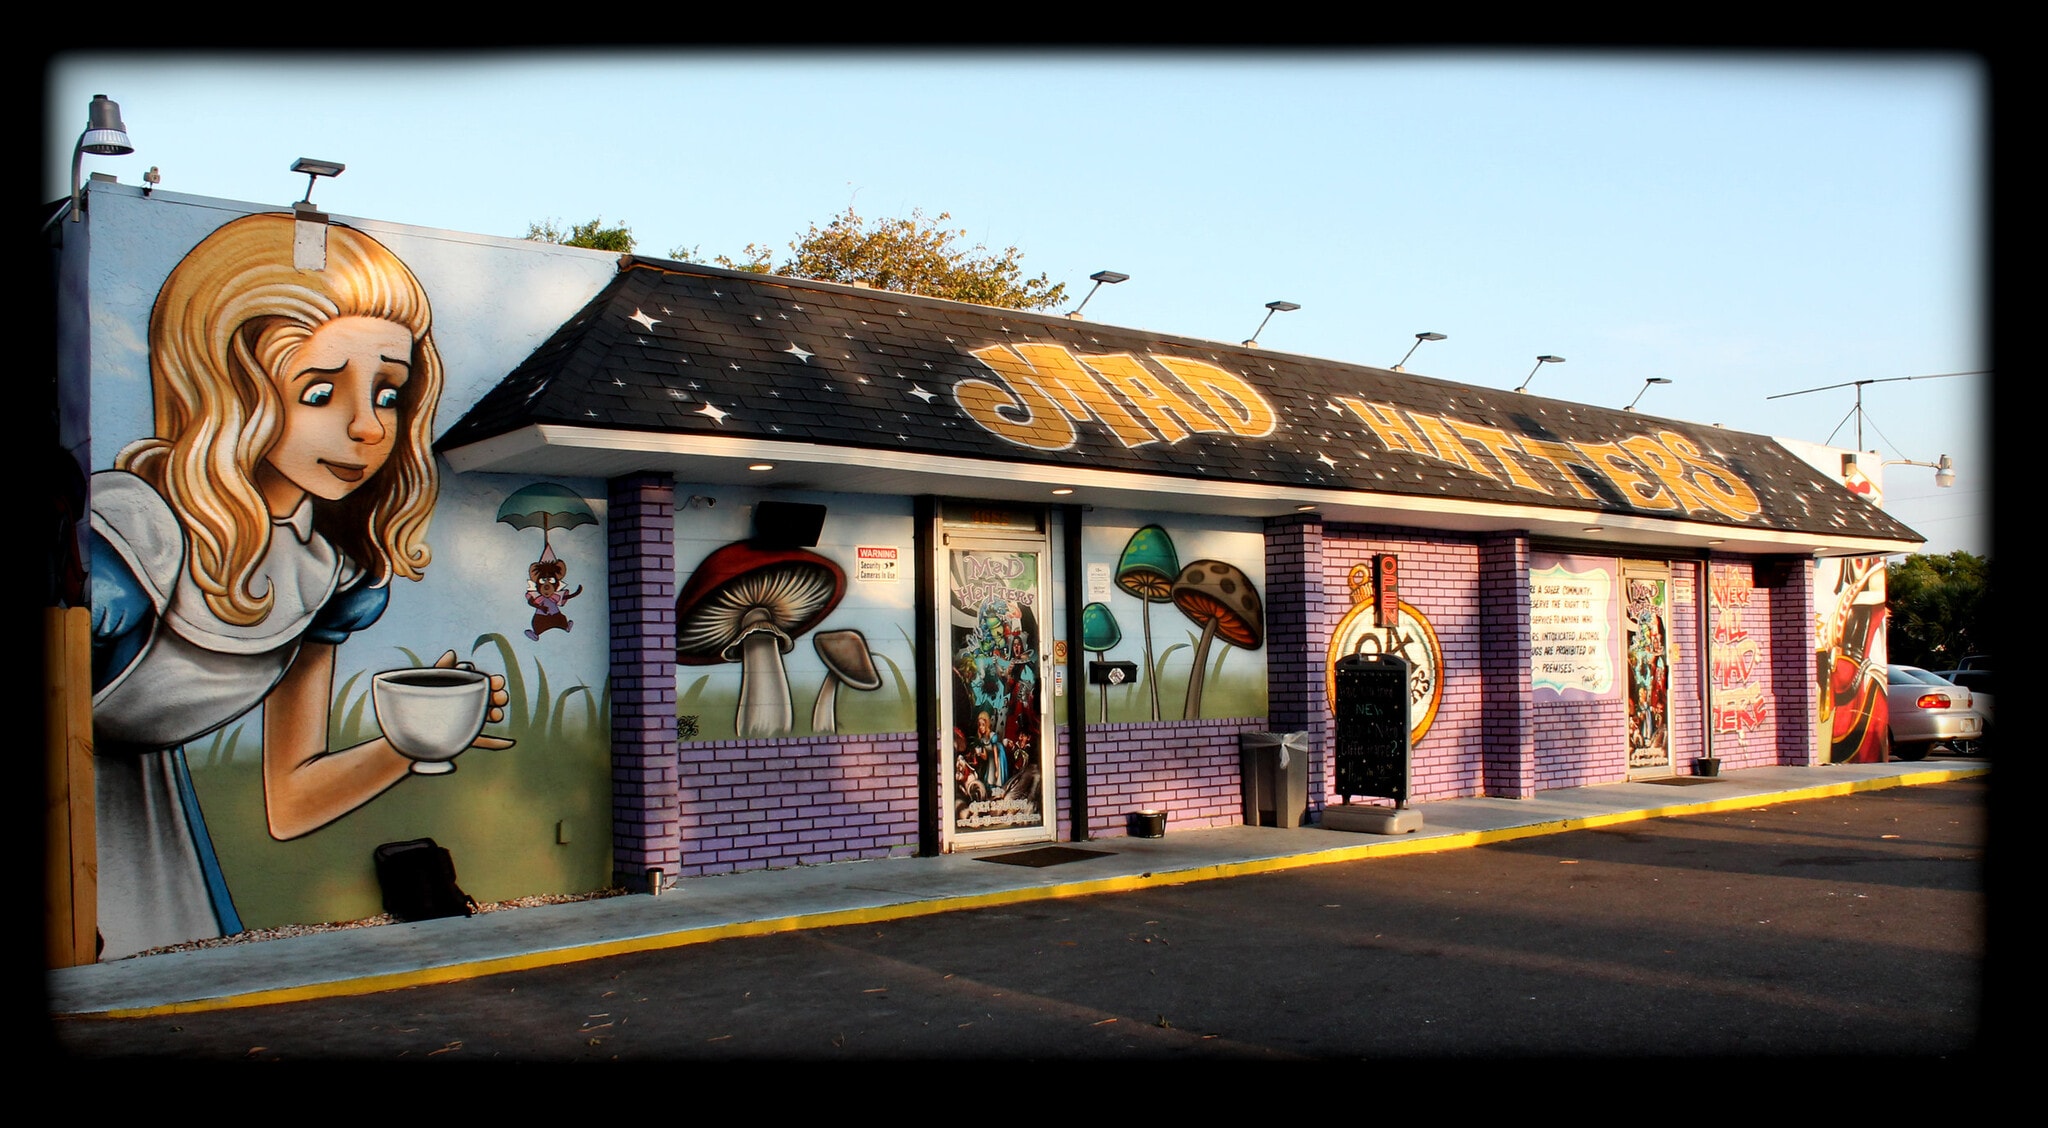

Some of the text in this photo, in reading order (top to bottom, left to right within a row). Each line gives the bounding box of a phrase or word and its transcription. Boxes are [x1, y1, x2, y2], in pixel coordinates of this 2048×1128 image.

[953, 343, 1761, 521] MAD HATTERS
[859, 549, 897, 559] WARNING
[861, 561, 880, 571] Security
[861, 571, 880, 579] Cameras
[1381, 556, 1398, 626] OPEN
[1563, 600, 1580, 609] RIGHT
[1582, 600, 1590, 609] TO
[1532, 614, 1593, 625] SERVICE TO ANYONE WHO
[1712, 608, 1749, 645] ALL
[1544, 646, 1554, 656] ARE
[1555, 645, 1587, 656] PROHIBITED
[1542, 663, 1575, 674] PREMISES.
[1711, 639, 1758, 689] MAD
